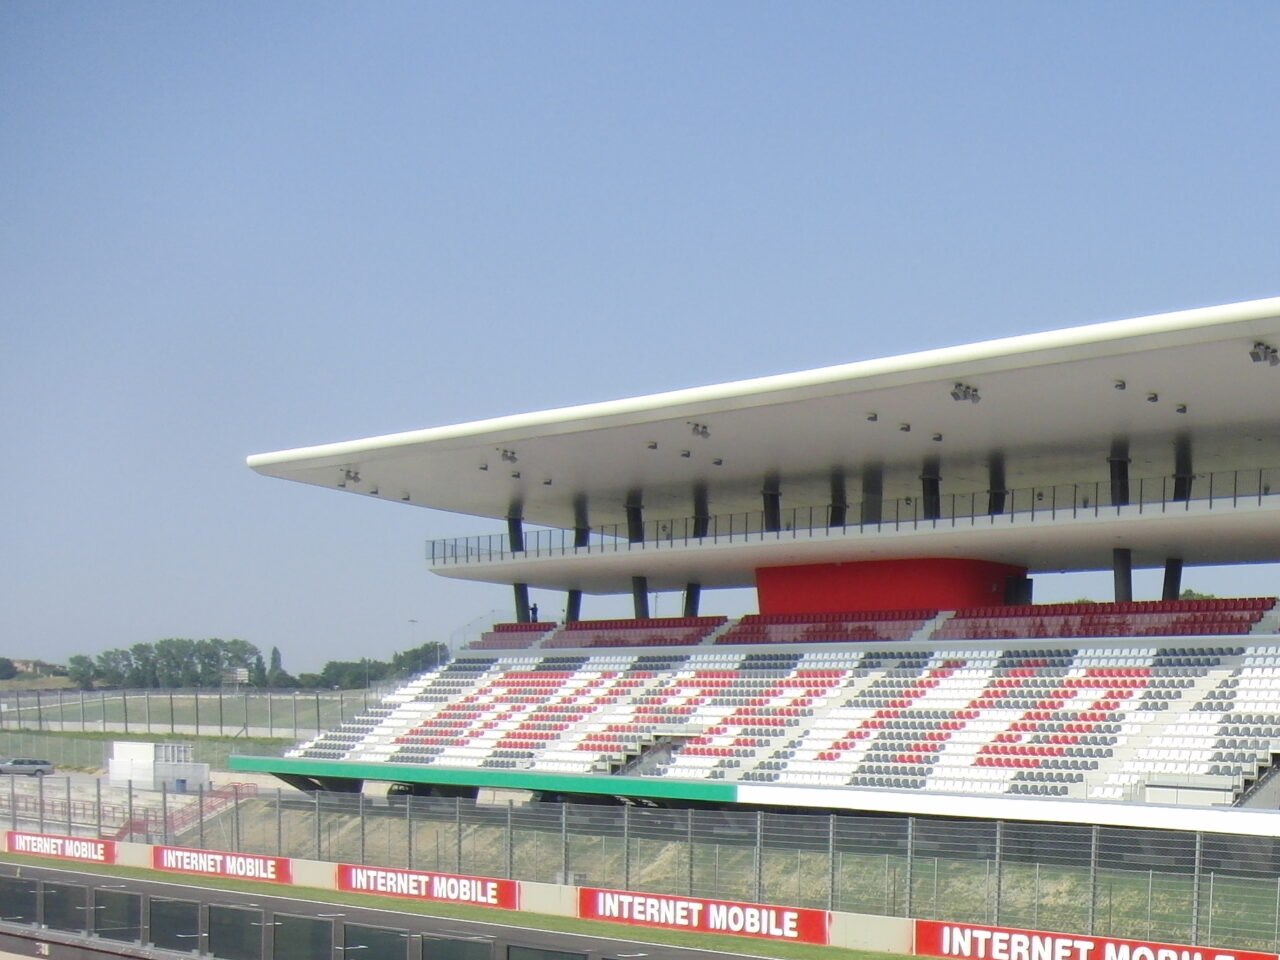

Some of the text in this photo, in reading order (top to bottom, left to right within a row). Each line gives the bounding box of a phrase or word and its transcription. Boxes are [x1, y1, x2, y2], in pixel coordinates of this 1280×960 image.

[15, 835, 104, 860] INTERNET MOBILE
[163, 849, 276, 879] INTERNET MOBILE
[352, 868, 498, 905] INTERNET MOBILE
[598, 892, 799, 938] INTERNET MOBILE
